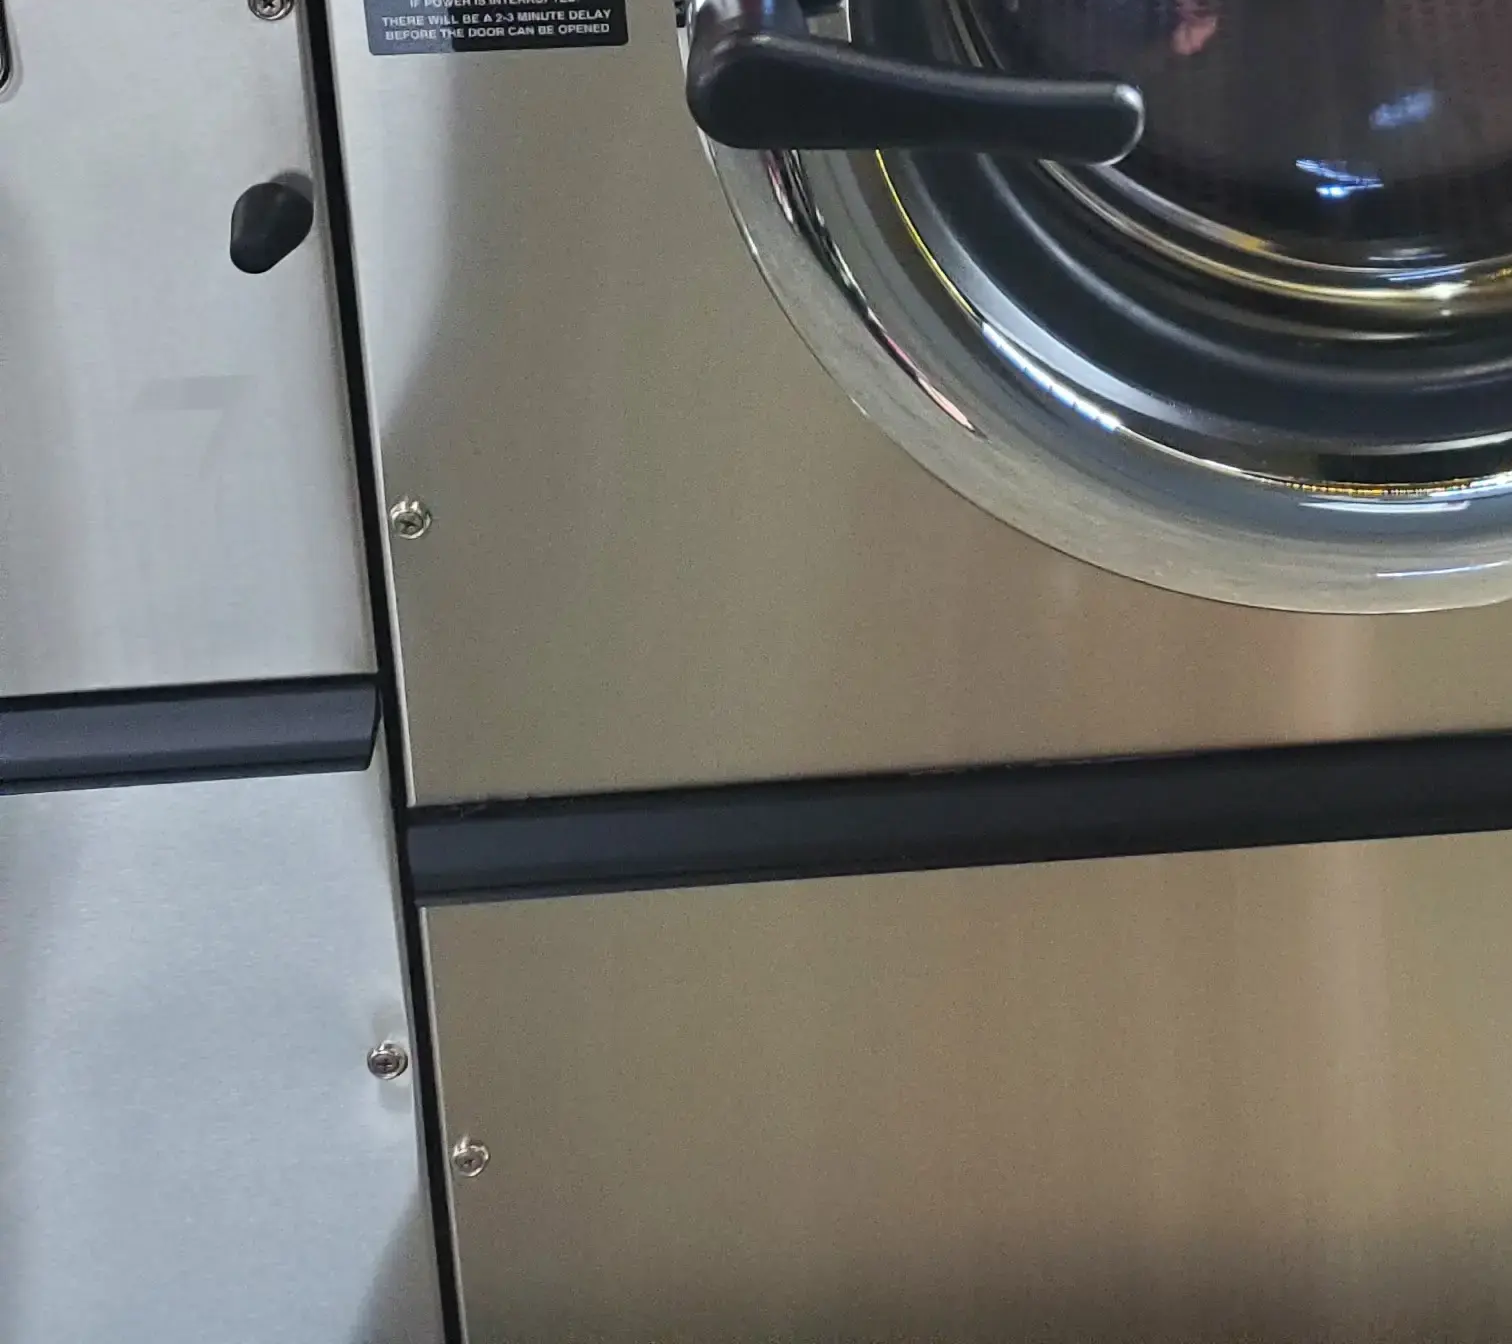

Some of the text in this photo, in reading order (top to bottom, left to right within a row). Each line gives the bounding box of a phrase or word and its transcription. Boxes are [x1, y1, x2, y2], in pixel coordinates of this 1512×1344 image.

[410, 0, 420, 9] IF
[382, 9, 612, 27] THERE WILL BE A 2-3 MINUTE DELAY
[386, 23, 610, 41] BEFORE THE DOOR CAN BE OPENED
